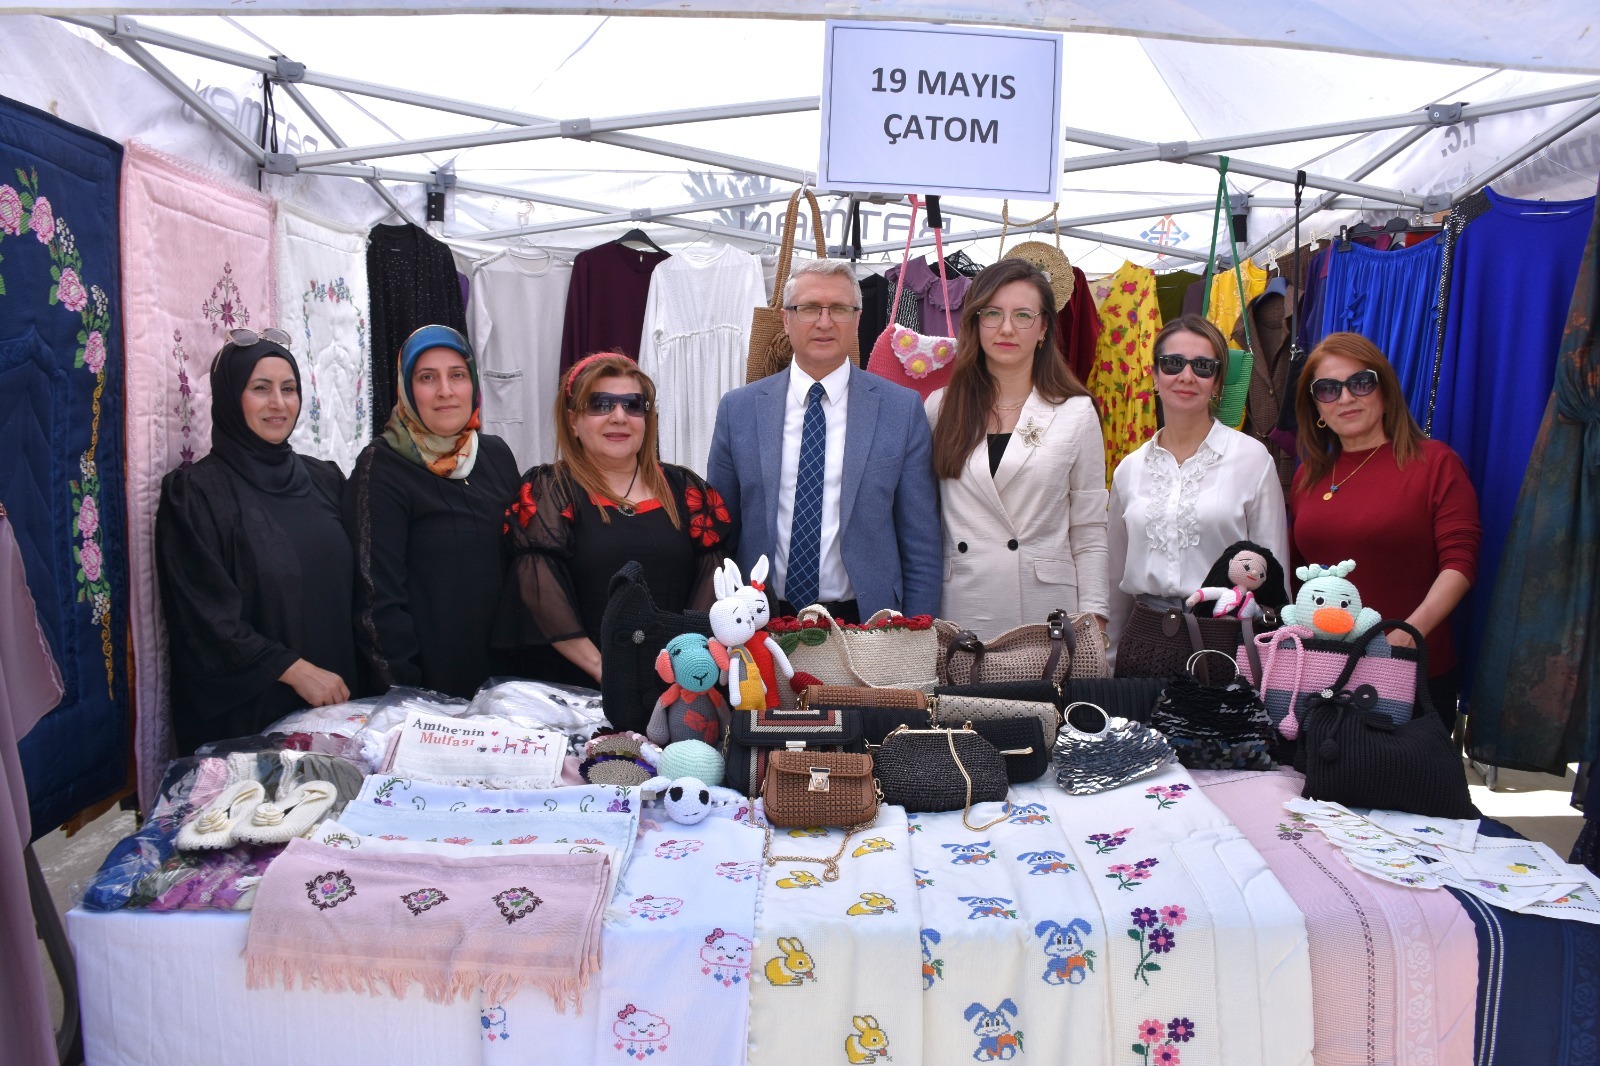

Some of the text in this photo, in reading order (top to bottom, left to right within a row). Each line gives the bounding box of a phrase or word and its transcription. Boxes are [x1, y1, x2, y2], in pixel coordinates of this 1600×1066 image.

[872, 67, 1016, 100] 19 MAYIS
[884, 113, 999, 145] ÇATOM
